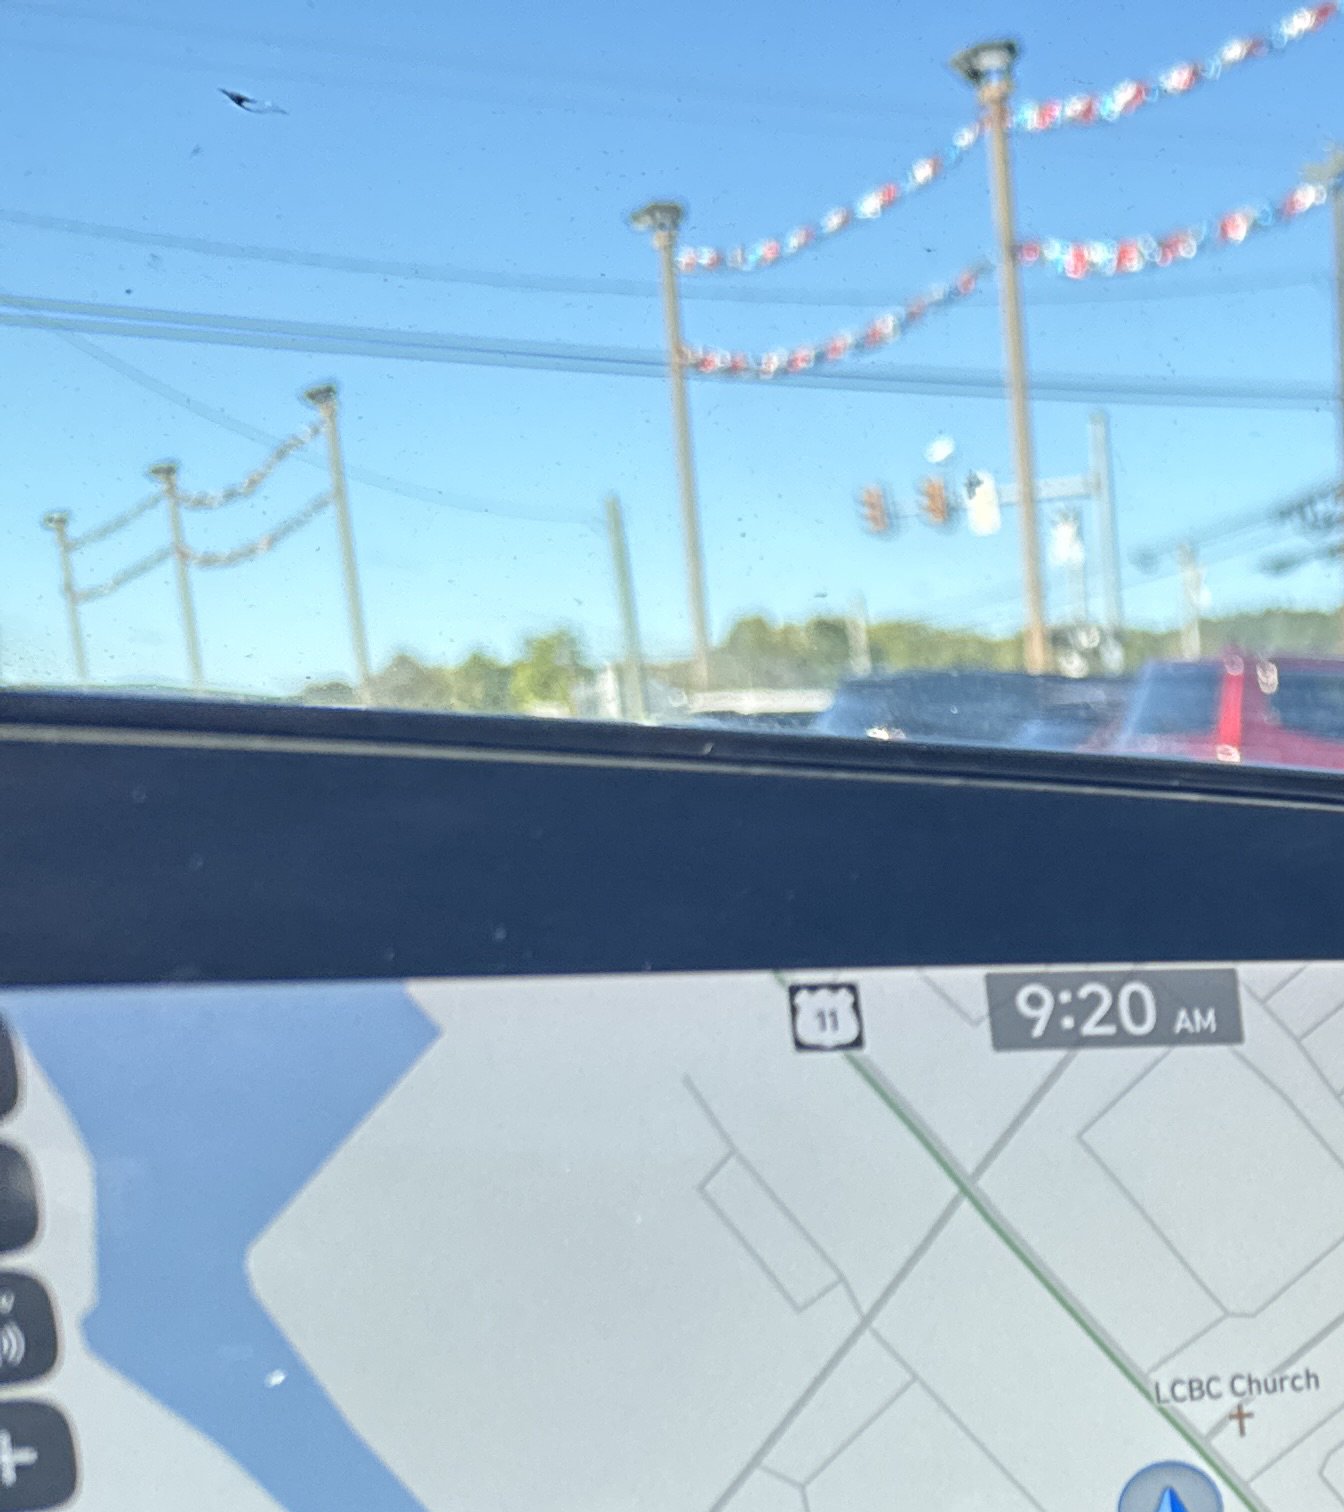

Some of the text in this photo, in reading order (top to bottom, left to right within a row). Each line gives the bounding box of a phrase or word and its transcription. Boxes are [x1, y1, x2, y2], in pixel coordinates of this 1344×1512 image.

[816, 1009, 840, 1033] 11
[1015, 981, 1217, 1038] 9:20 AM
[1155, 1369, 1321, 1405] LCBC Church
